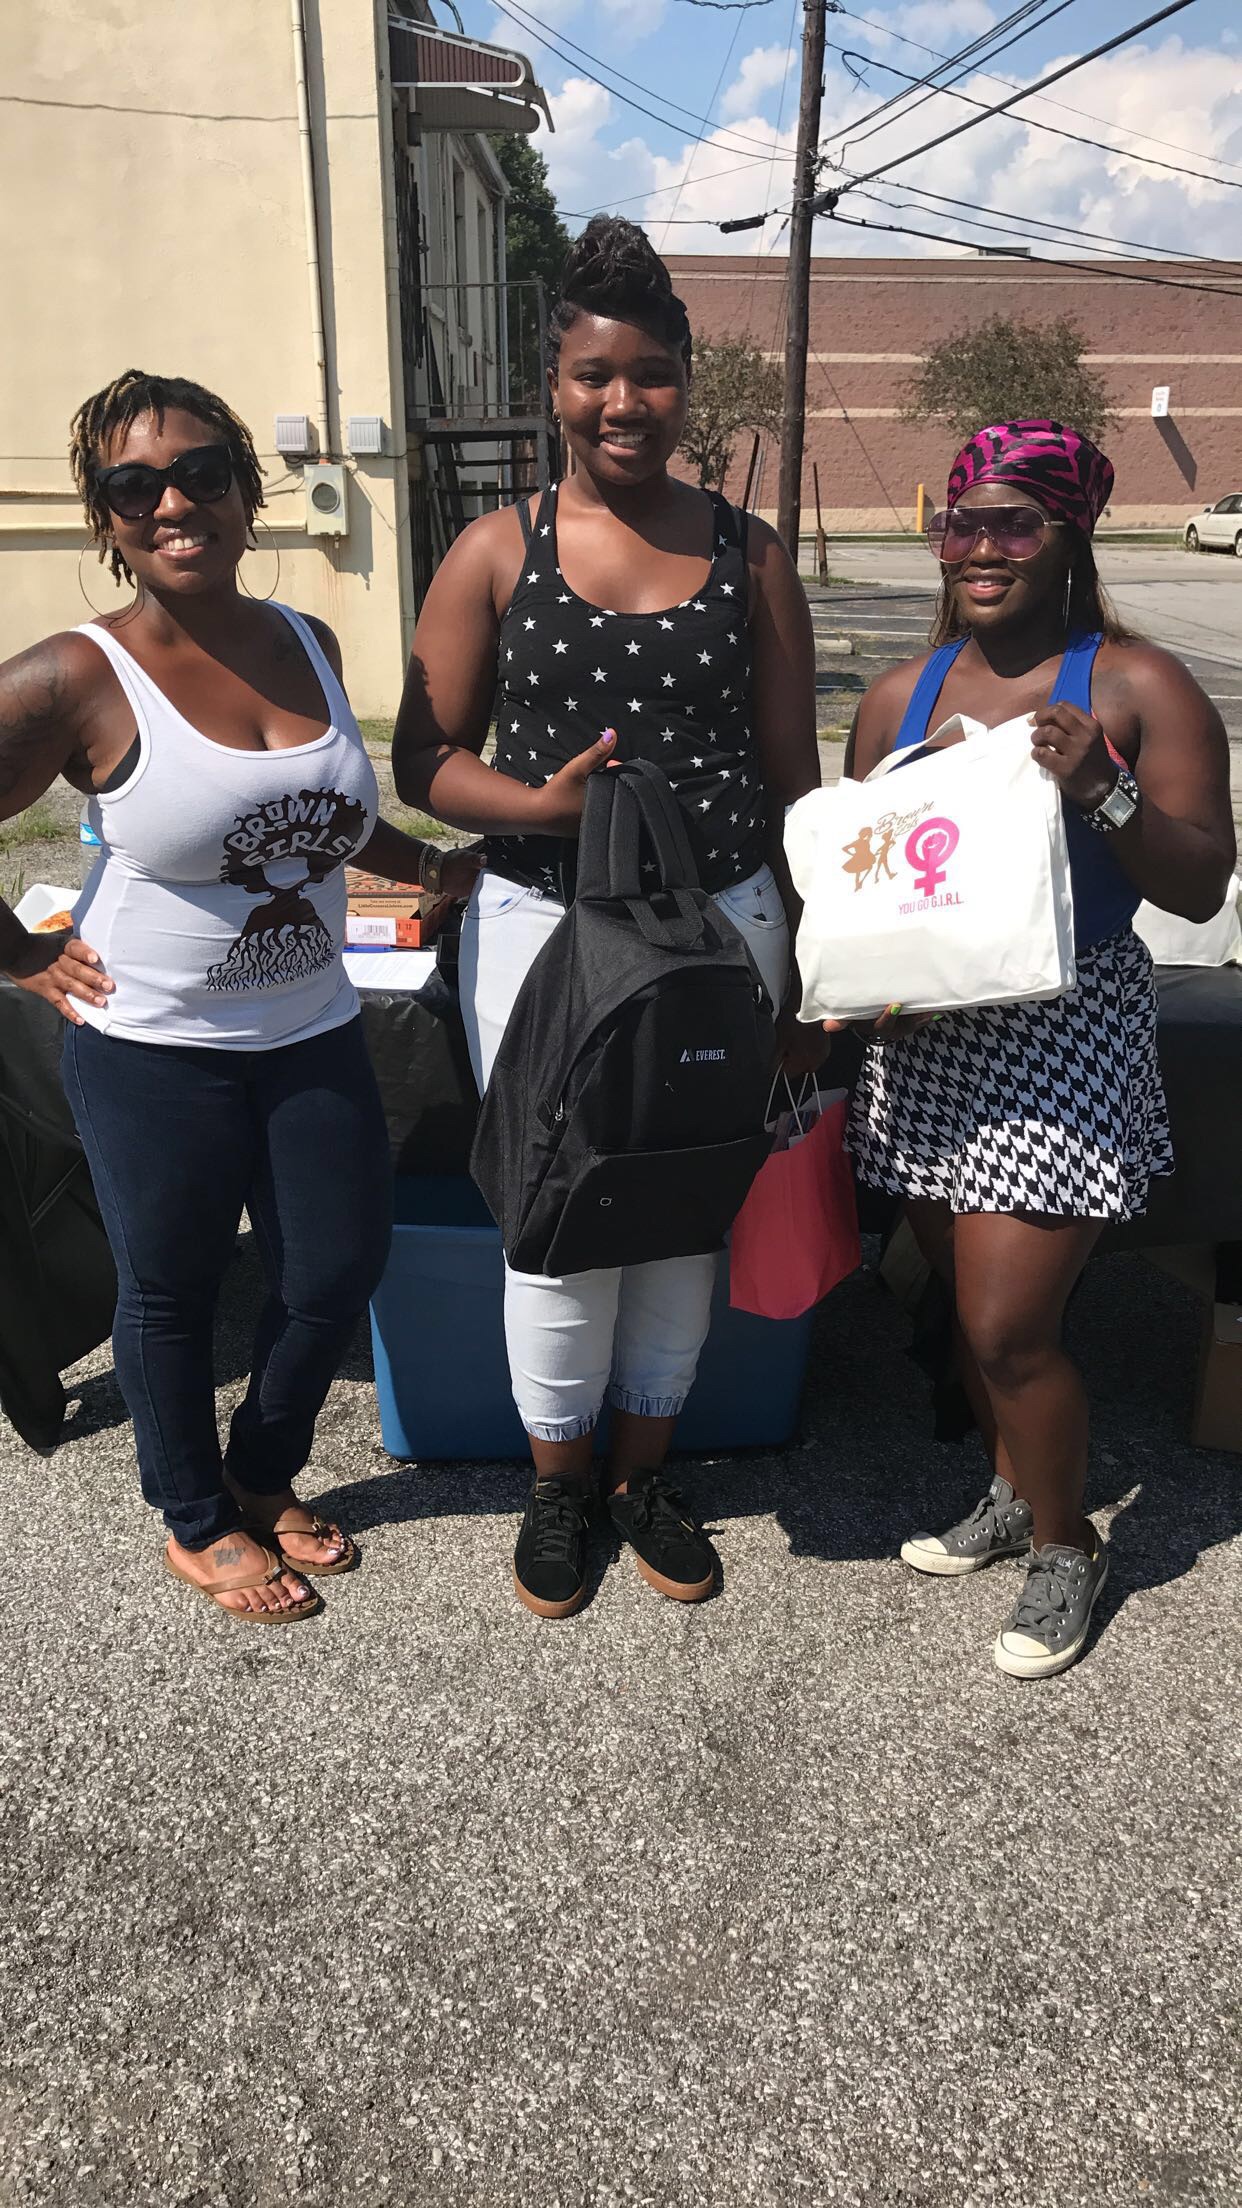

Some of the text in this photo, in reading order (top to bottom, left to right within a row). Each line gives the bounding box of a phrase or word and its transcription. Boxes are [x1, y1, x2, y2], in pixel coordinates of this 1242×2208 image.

[227, 799, 337, 852] BROWN
[241, 827, 352, 868] GIRLS
[898, 901, 916, 916] YOU
[917, 898, 930, 912] GO
